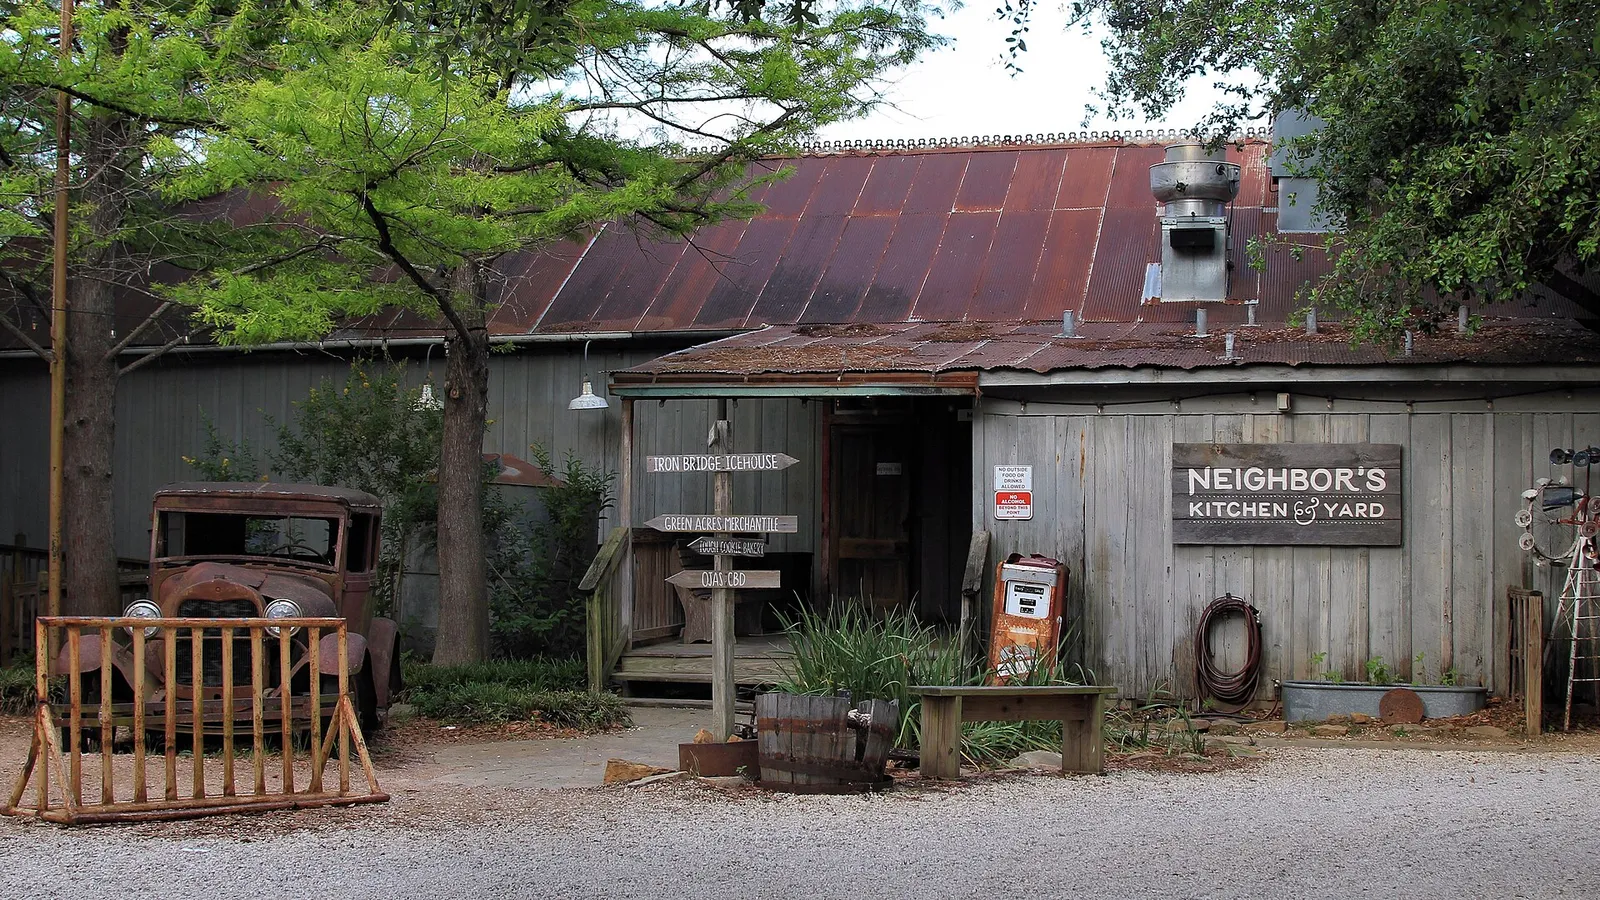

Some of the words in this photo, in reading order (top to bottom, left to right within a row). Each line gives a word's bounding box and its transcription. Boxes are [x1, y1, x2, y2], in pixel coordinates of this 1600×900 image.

[653, 456, 680, 472] IRON
[683, 455, 721, 471] BRIDGE
[725, 454, 778, 471] ICEHOUSE
[1188, 466, 1387, 496] NEIGHBOR'S
[1189, 501, 1288, 518] KITCHEN
[1294, 497, 1320, 526] &
[1323, 502, 1385, 518] YARD
[664, 516, 693, 531] GREEN
[695, 516, 721, 531] ACRES
[724, 516, 779, 531] MERCHANTILE
[699, 540, 719, 554] TOUGH
[720, 541, 742, 554] COOKIE
[743, 542, 764, 554] BAKERY
[701, 571, 724, 587] OJAS
[728, 571, 746, 587] CBD
